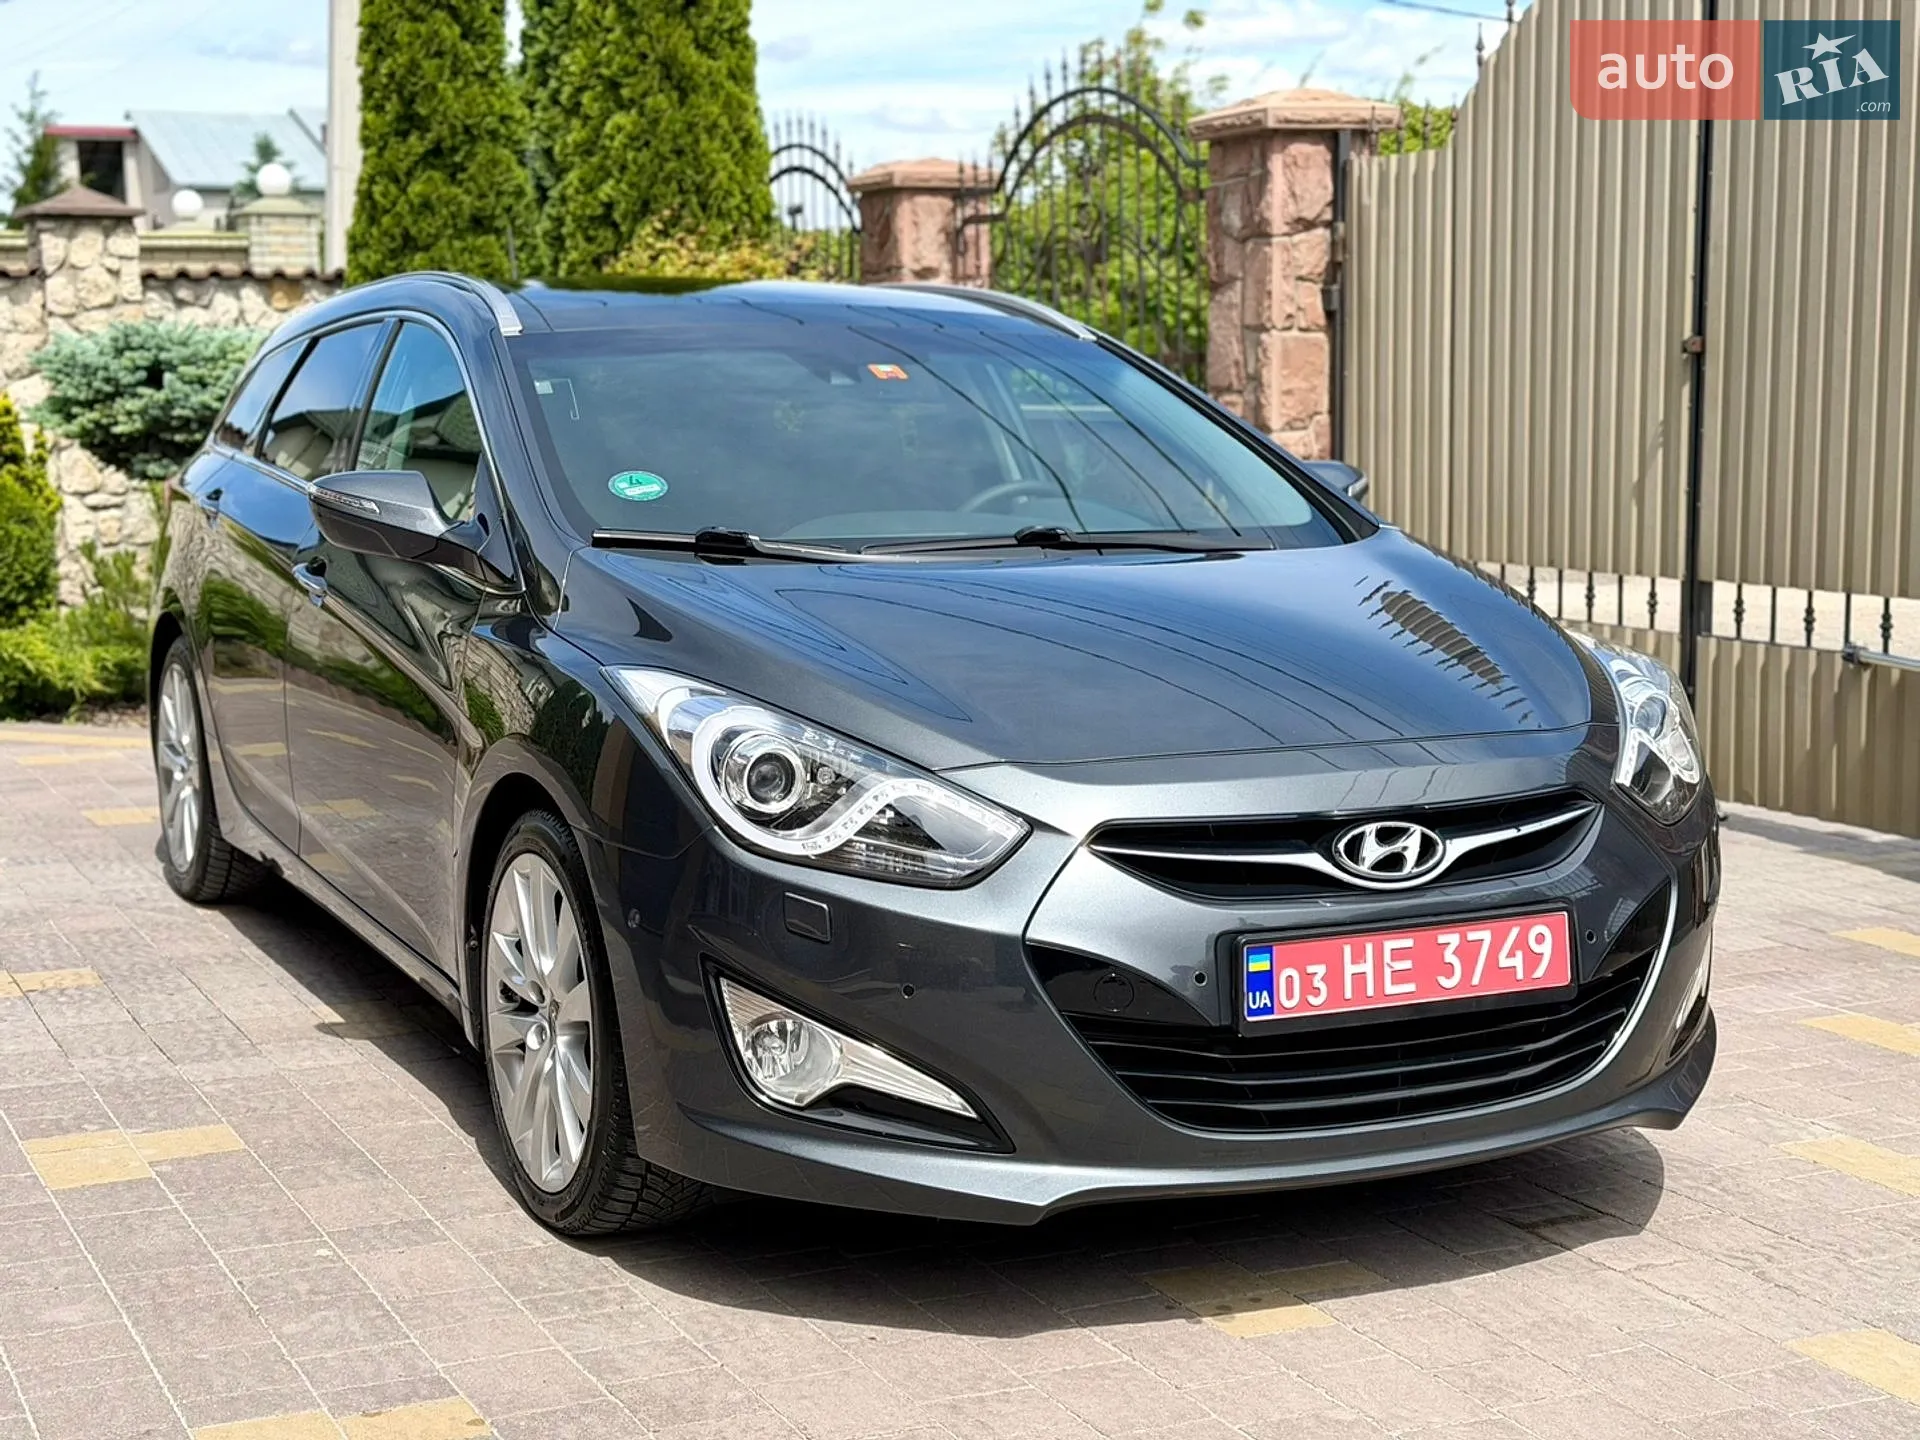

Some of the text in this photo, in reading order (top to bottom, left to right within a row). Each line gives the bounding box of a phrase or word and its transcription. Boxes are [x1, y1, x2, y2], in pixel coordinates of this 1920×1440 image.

[1279, 924, 1553, 1010] 03 HE 3749
[1248, 991, 1272, 1010] UA
